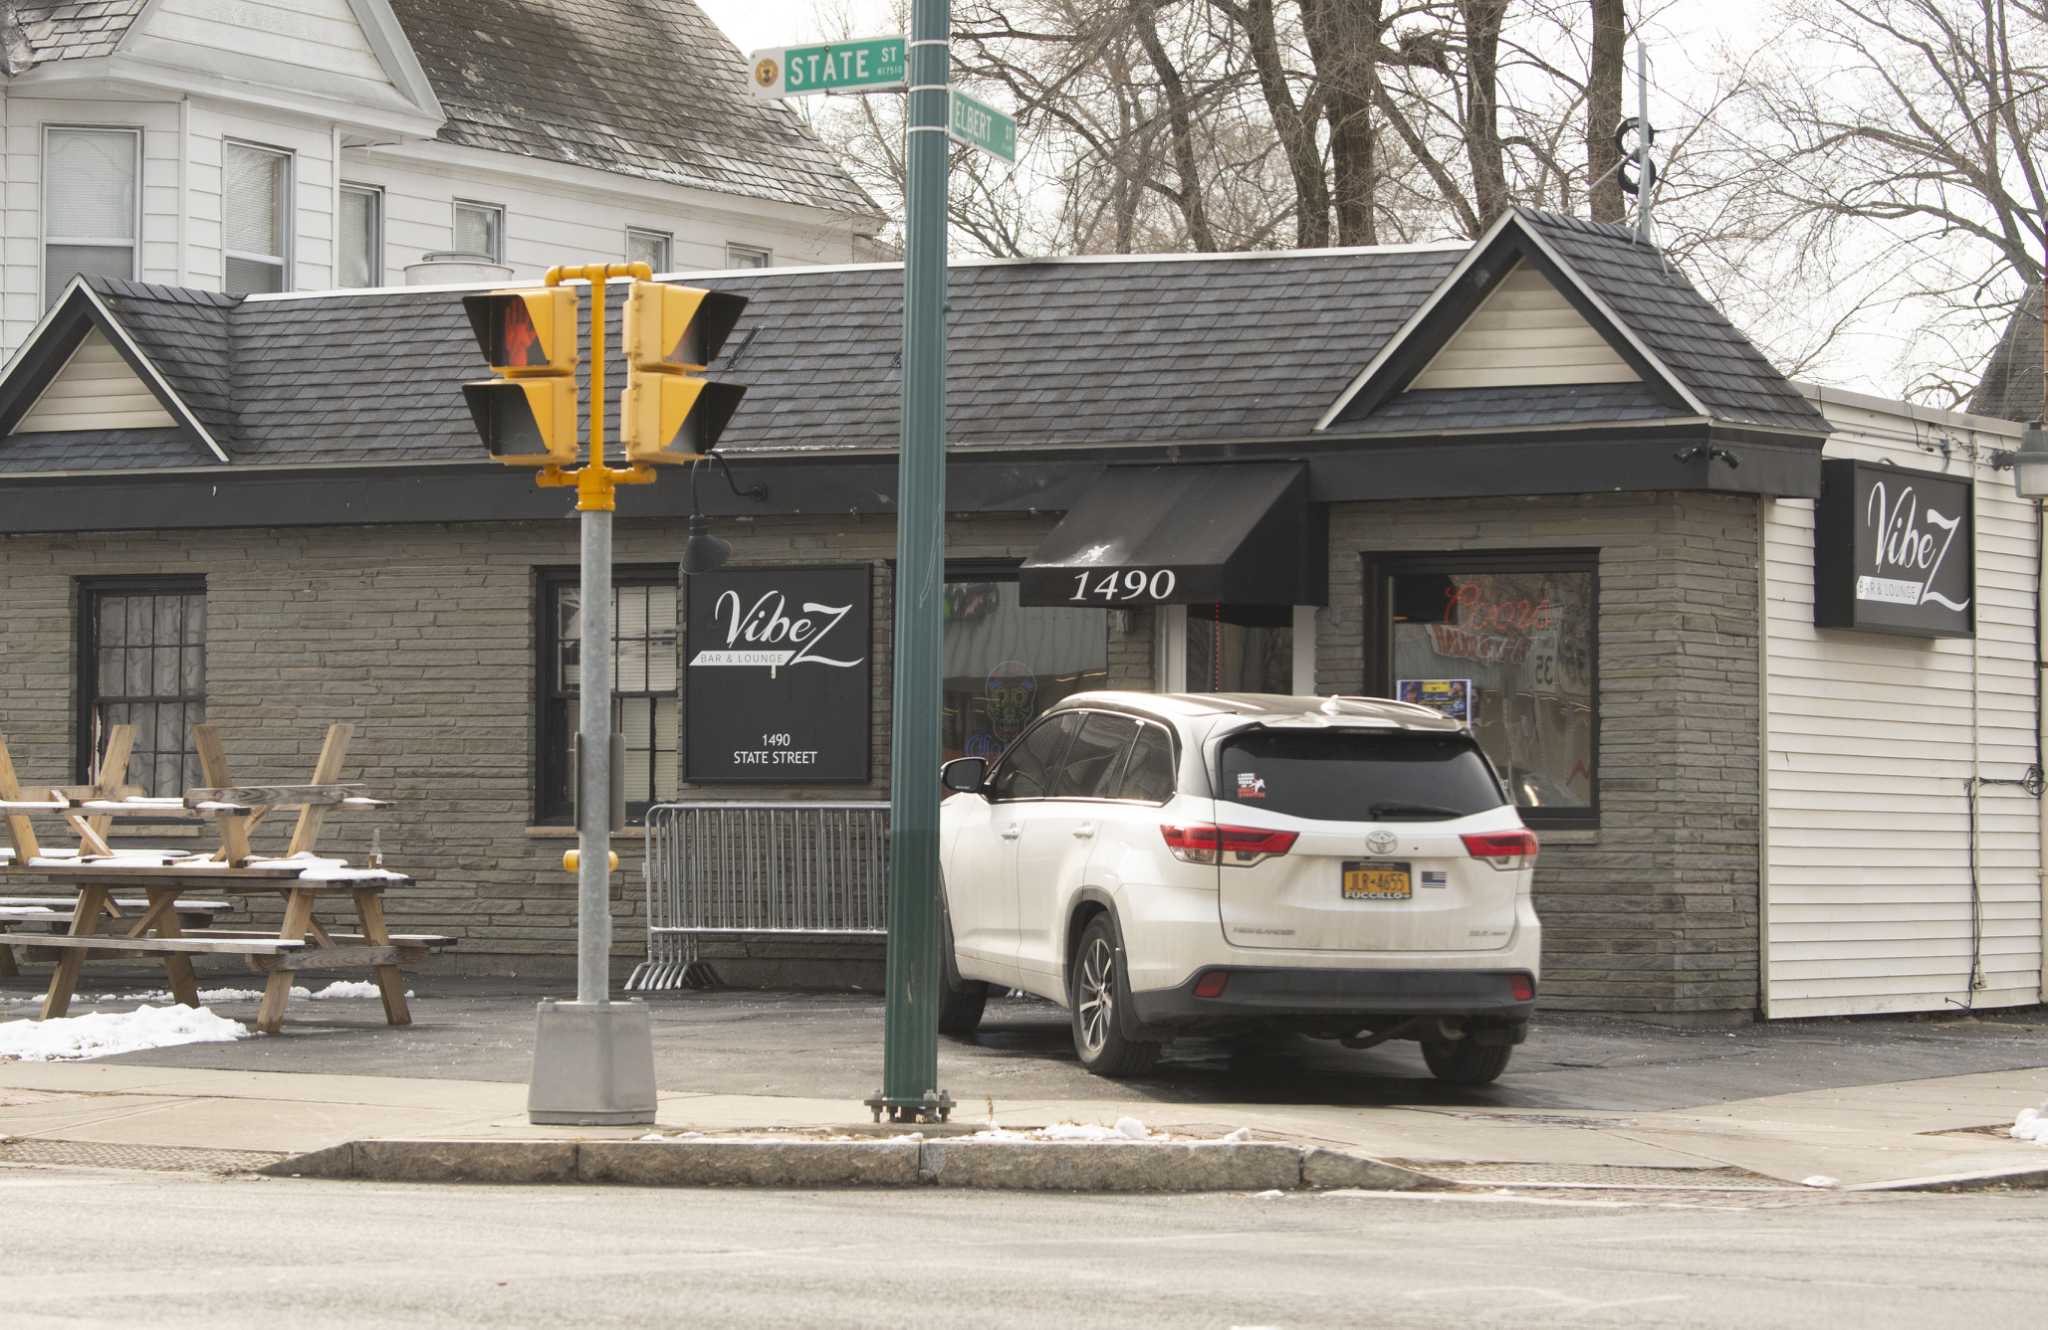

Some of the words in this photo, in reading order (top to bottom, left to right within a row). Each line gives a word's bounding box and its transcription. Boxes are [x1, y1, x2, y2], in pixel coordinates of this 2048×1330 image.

[790, 50, 869, 86] STATE
[881, 46, 897, 63] ST
[954, 100, 992, 143] ELBERT
[1868, 481, 1970, 612] VibeZ
[1069, 569, 1176, 600] 1490
[715, 590, 864, 667] VibeZ
[700, 654, 722, 663] BAR
[727, 654, 734, 663] &
[738, 654, 784, 663] LOUNGE
[761, 733, 791, 746] 1490
[733, 751, 769, 764] STATE
[772, 751, 818, 764] STREET
[1344, 890, 1402, 899] FUCCILLO
